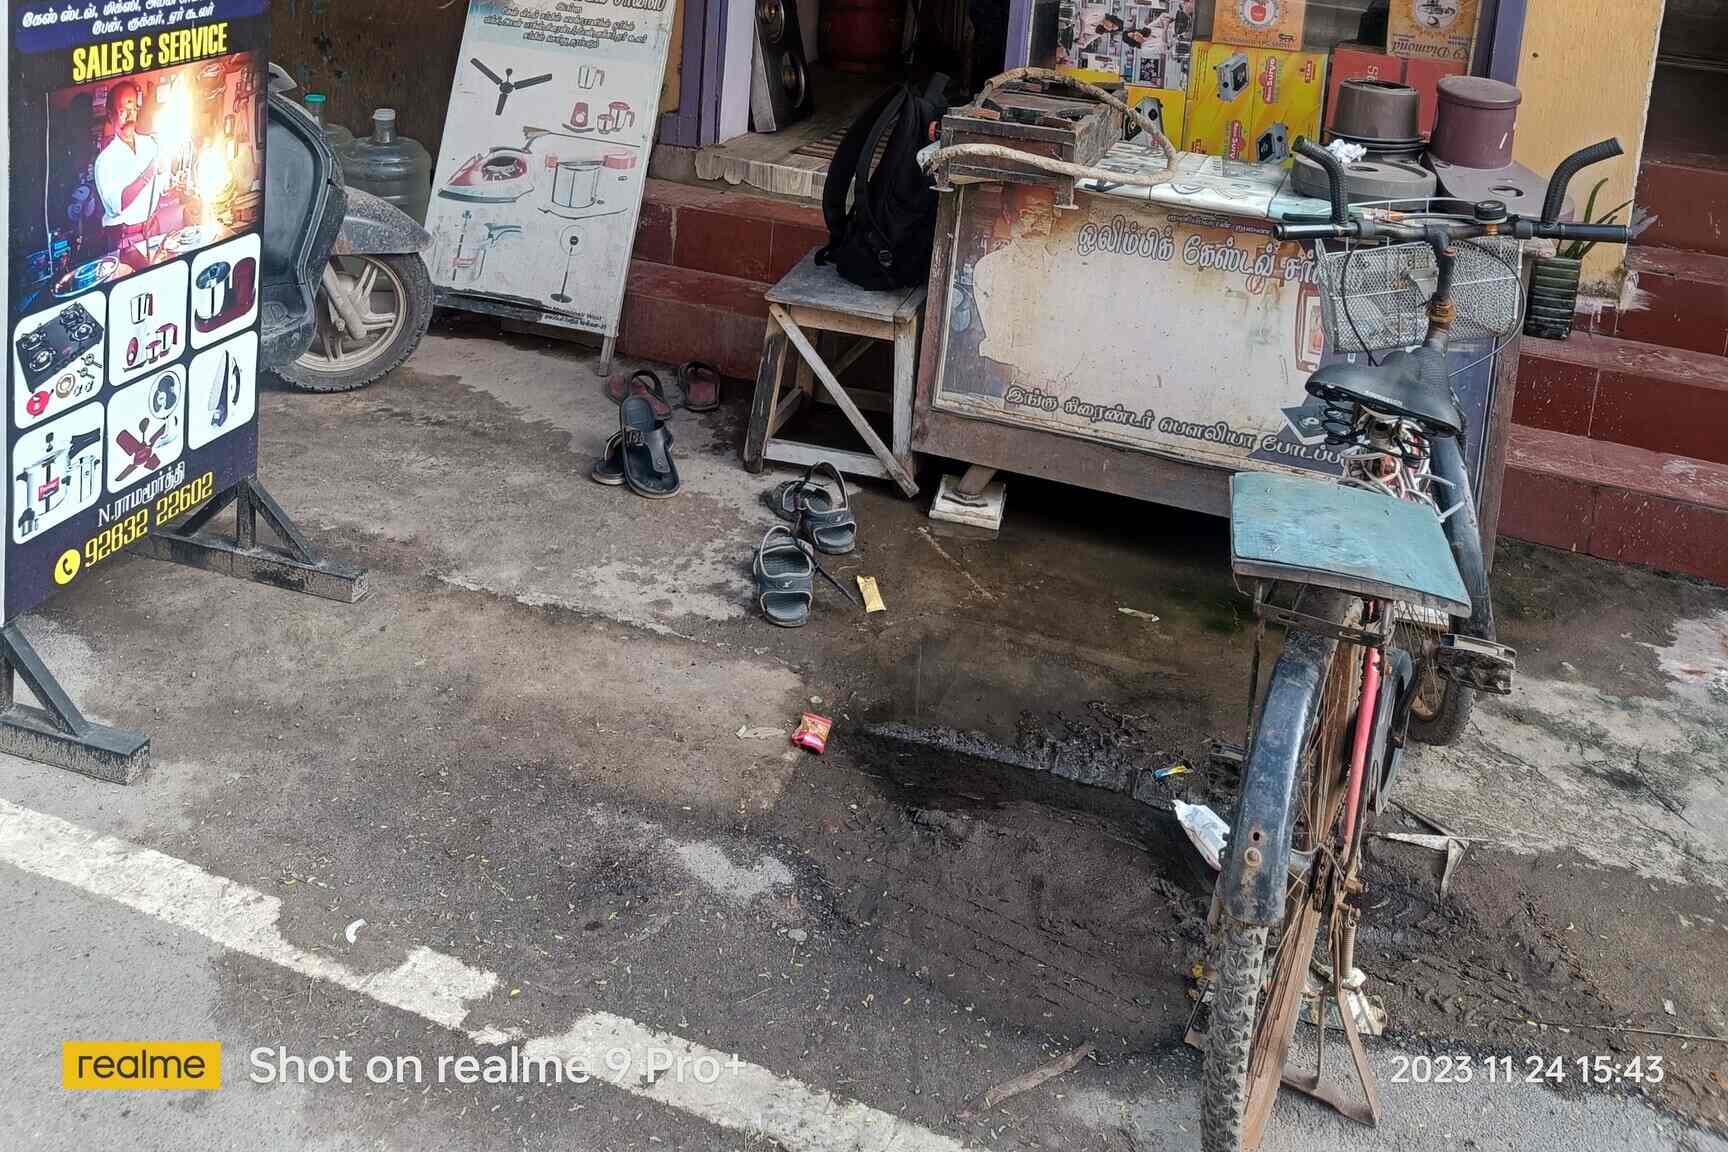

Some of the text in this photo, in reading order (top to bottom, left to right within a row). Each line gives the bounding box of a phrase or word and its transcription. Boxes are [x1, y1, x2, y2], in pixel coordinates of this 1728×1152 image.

[22, 8, 57, 28] கேஸ்
[73, 23, 228, 82] SALES & SERVICE
[1078, 215, 1175, 262] ஒலிம்பிக்
[1005, 383, 1059, 412] இங்கு
[84, 471, 214, 568] 92832 22602
[98, 460, 186, 528] N.ராமமூர்த்தி
